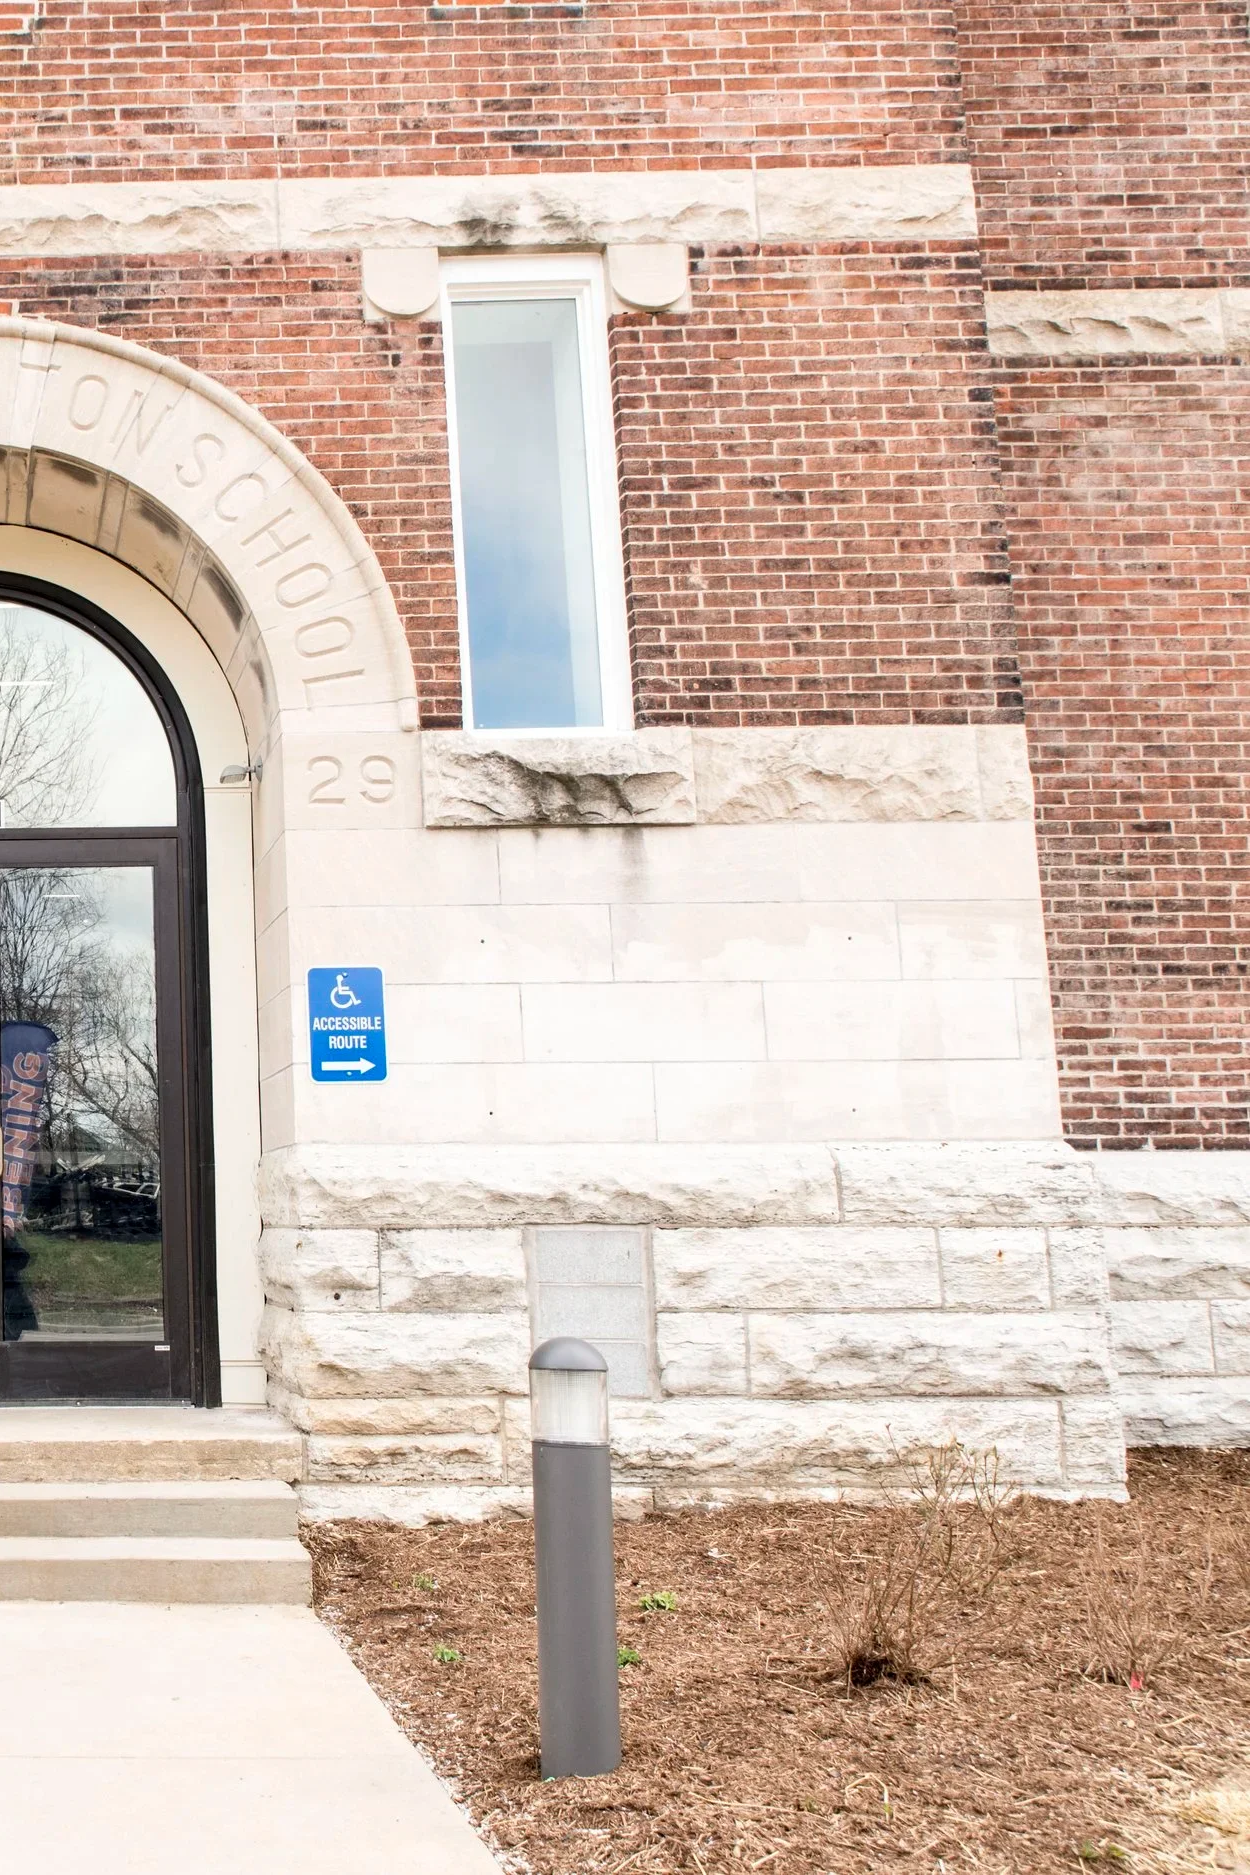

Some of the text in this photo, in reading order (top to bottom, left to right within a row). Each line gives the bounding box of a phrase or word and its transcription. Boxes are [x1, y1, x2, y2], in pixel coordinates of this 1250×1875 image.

[175, 432, 366, 710] SCHOOL
[307, 755, 398, 805] 29
[312, 1016, 382, 1031] ACCESSIBLE
[328, 1035, 368, 1049] ROUTE
